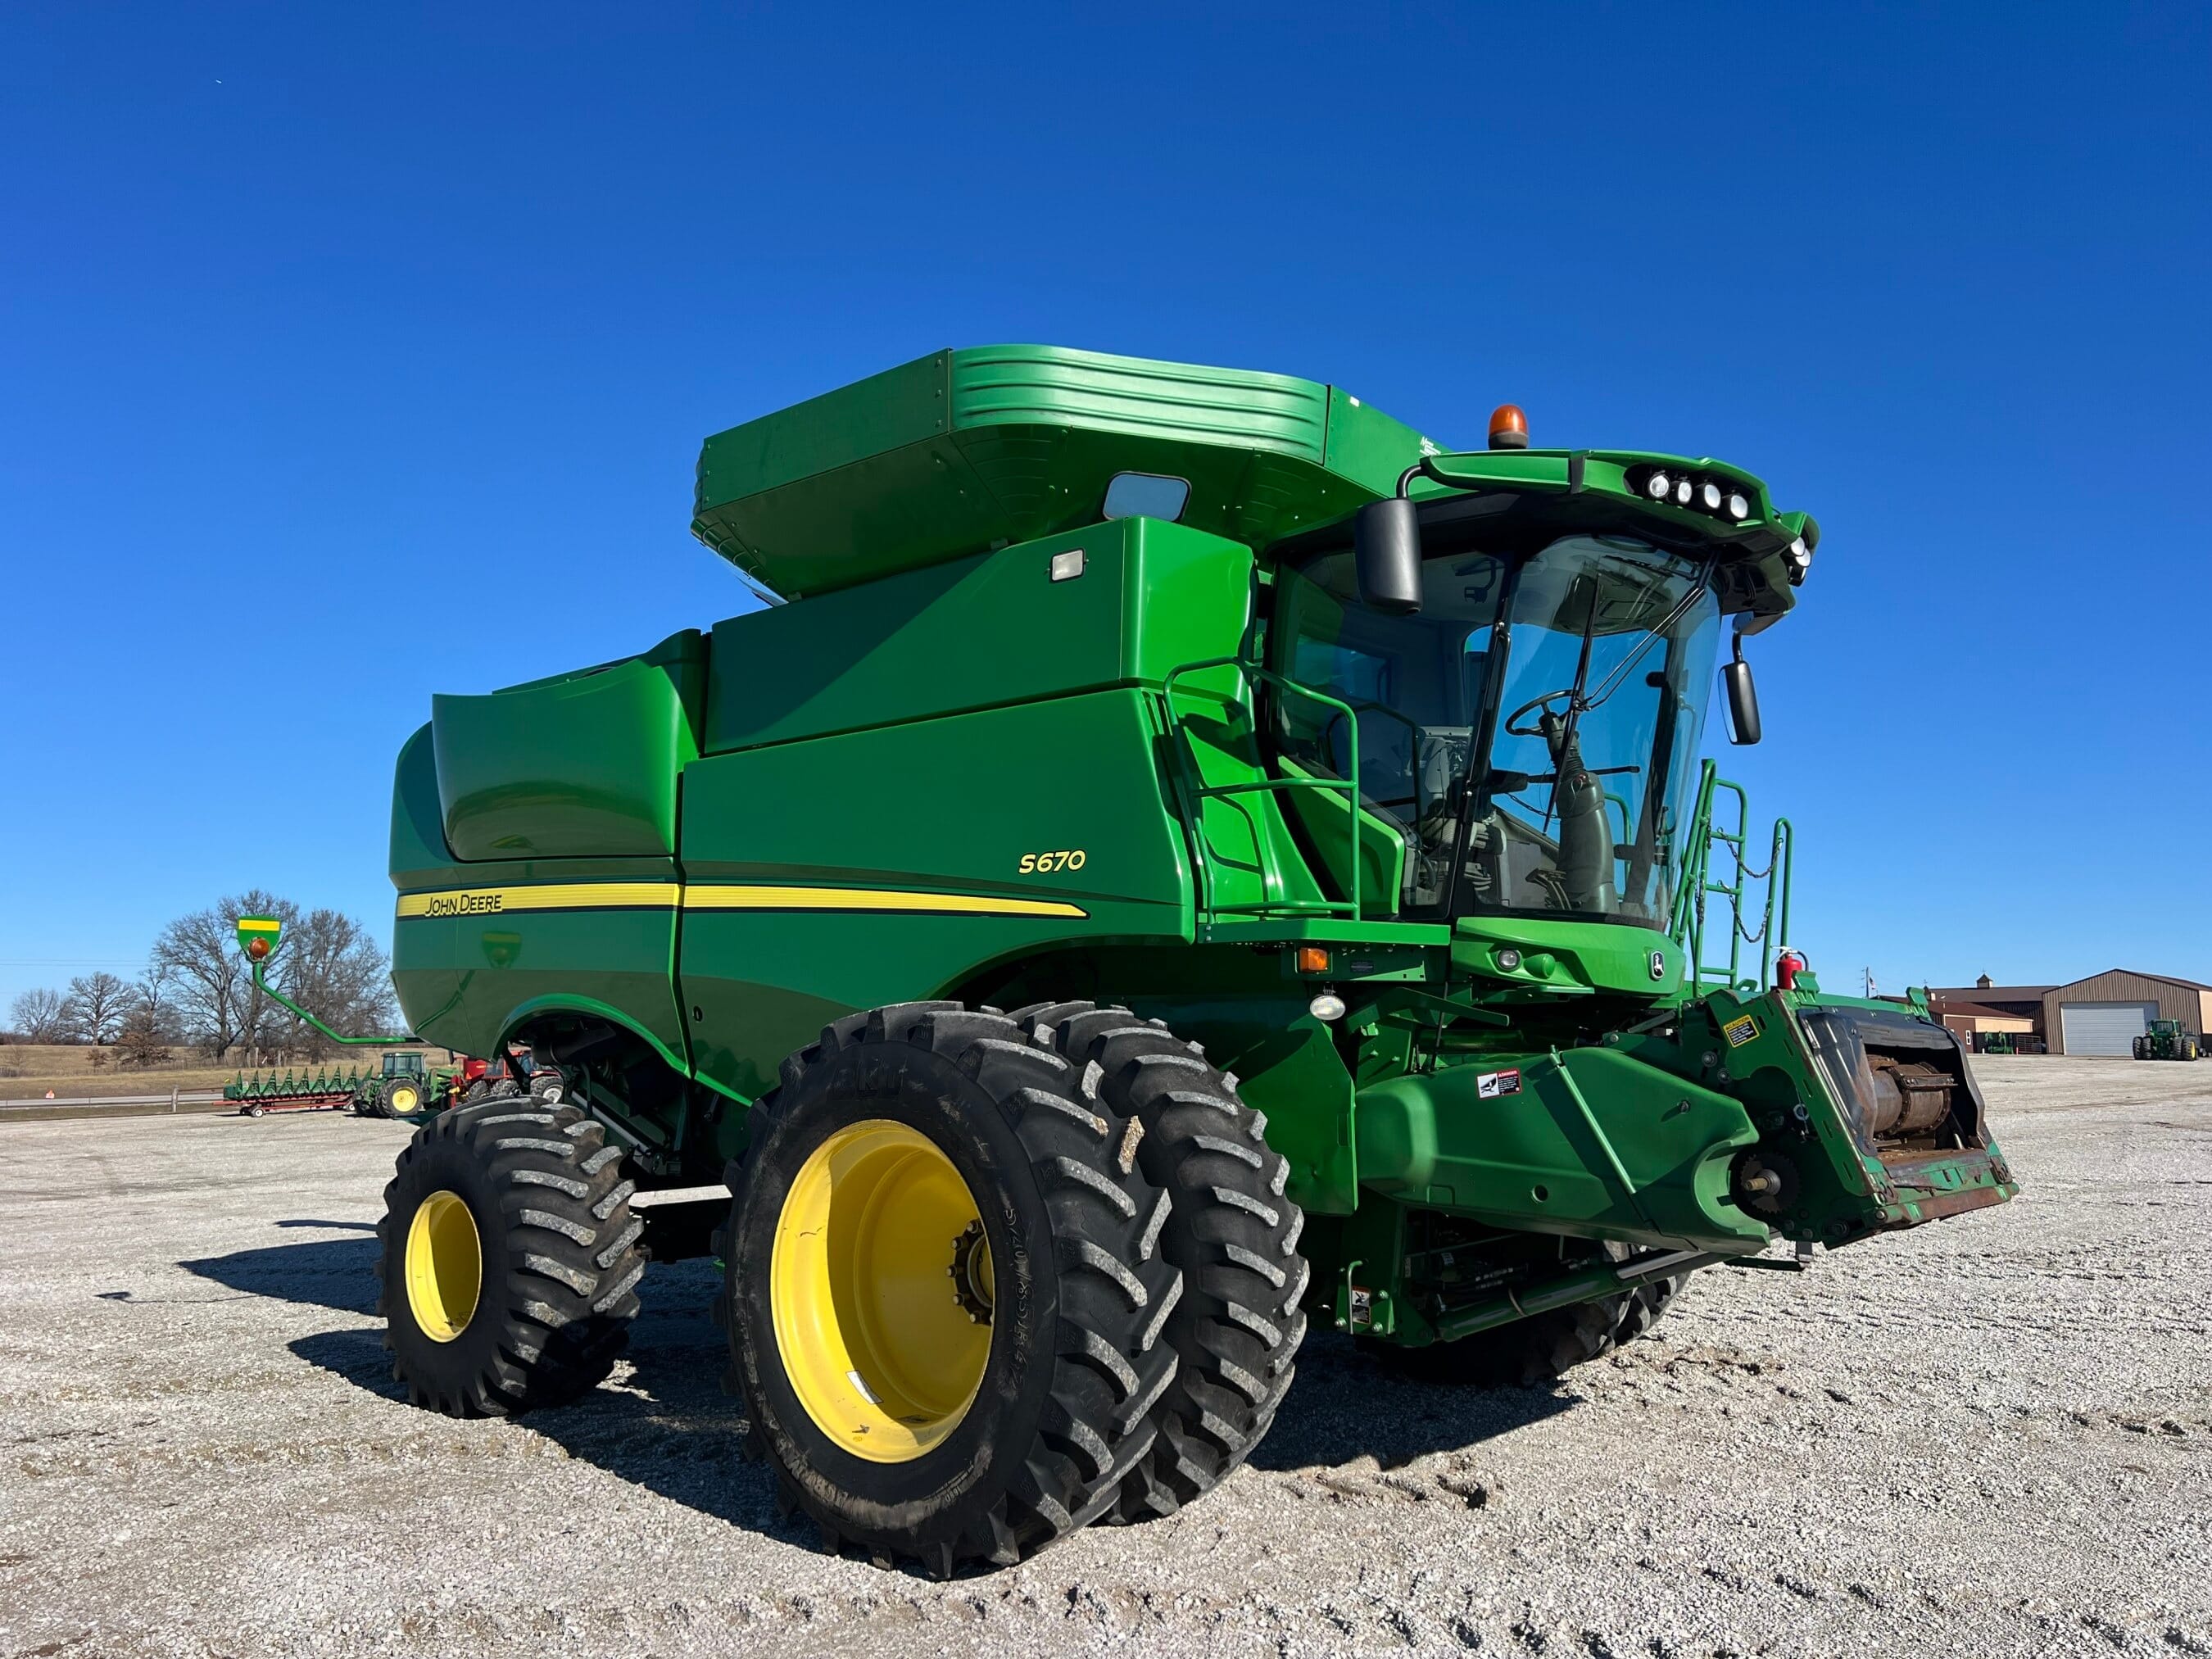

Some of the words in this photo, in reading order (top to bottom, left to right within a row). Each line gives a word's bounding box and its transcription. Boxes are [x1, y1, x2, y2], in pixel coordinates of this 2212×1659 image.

[1018, 849, 1086, 874] S670
[425, 897, 457, 914] JOHN
[460, 894, 502, 912] DEERE
[1729, 1017, 1750, 1029] CAUTION
